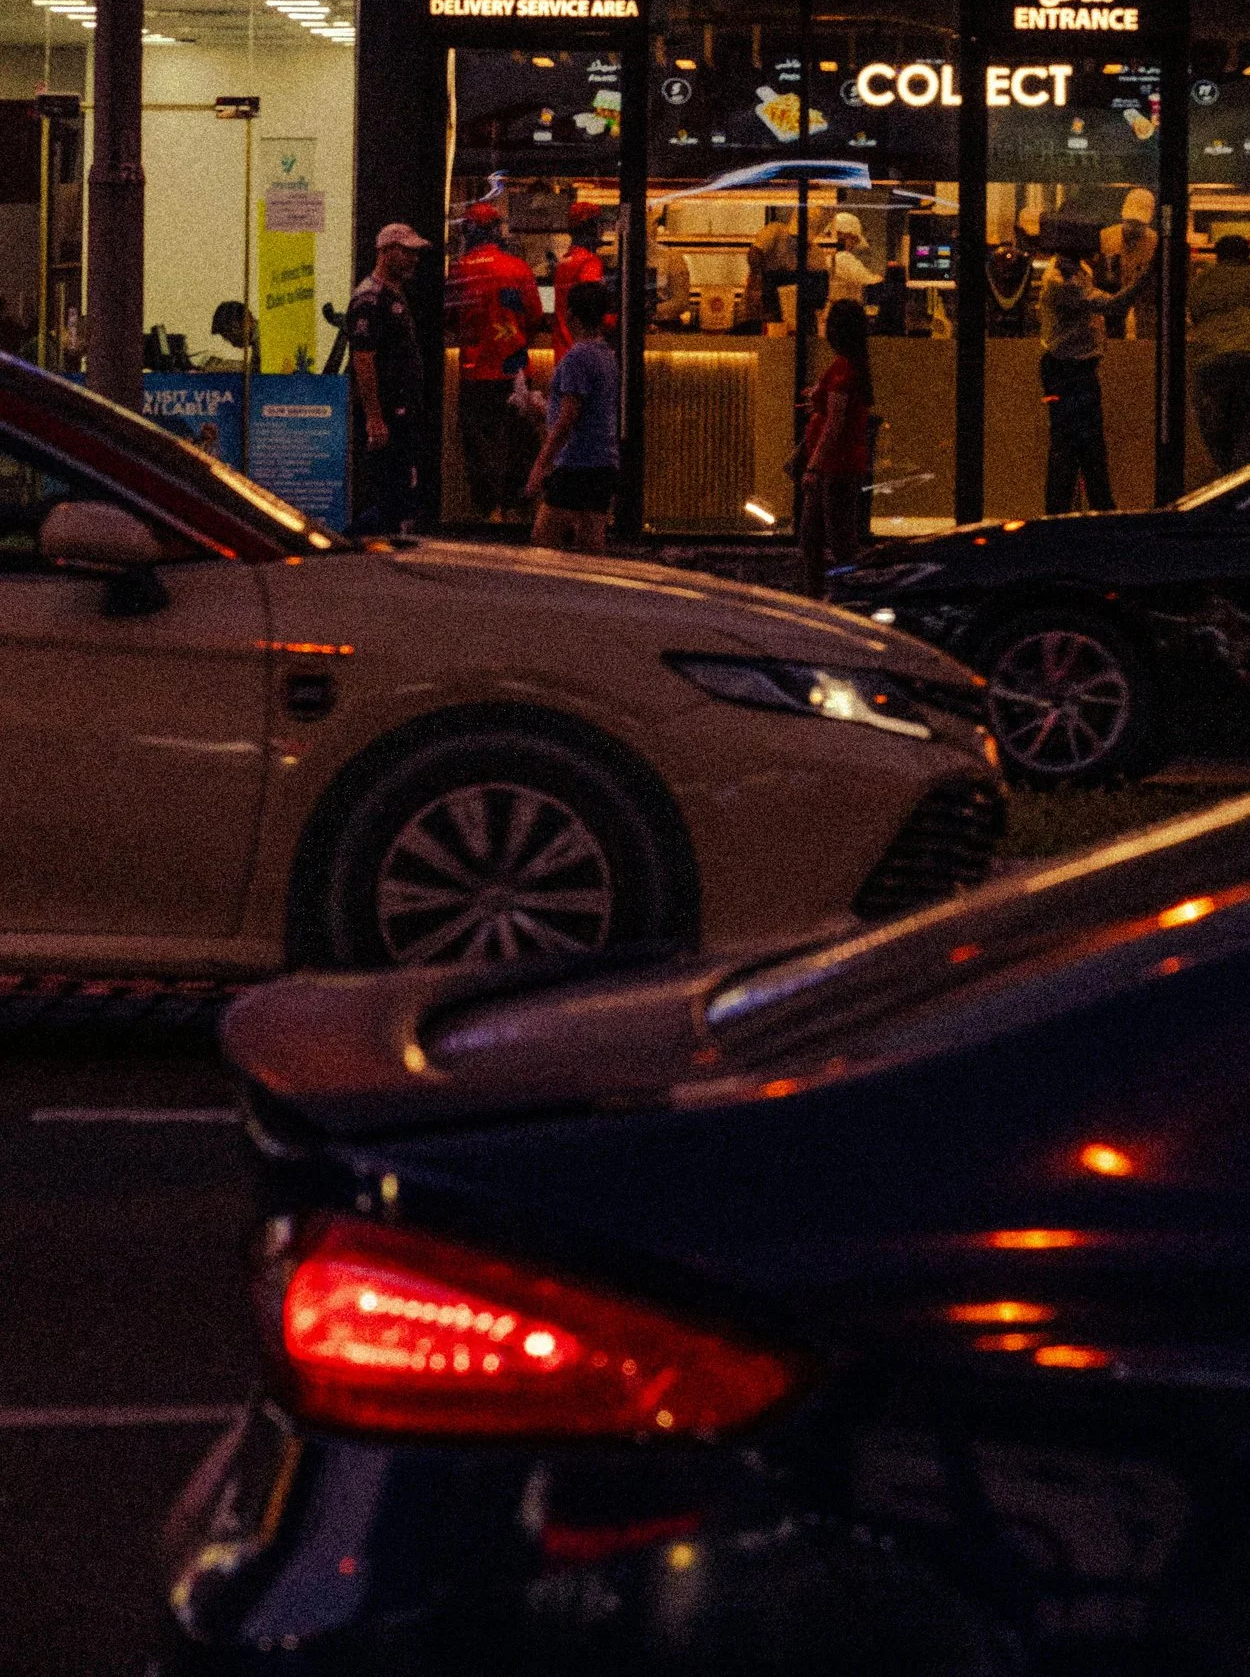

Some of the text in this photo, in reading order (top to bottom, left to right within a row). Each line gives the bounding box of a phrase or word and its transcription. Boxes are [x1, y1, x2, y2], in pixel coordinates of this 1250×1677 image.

[591, 0, 639, 18] AREA
[1013, 7, 1139, 32] ENTRANCE
[856, 61, 1074, 107] COLECT
[142, 402, 219, 416] AILABLE
